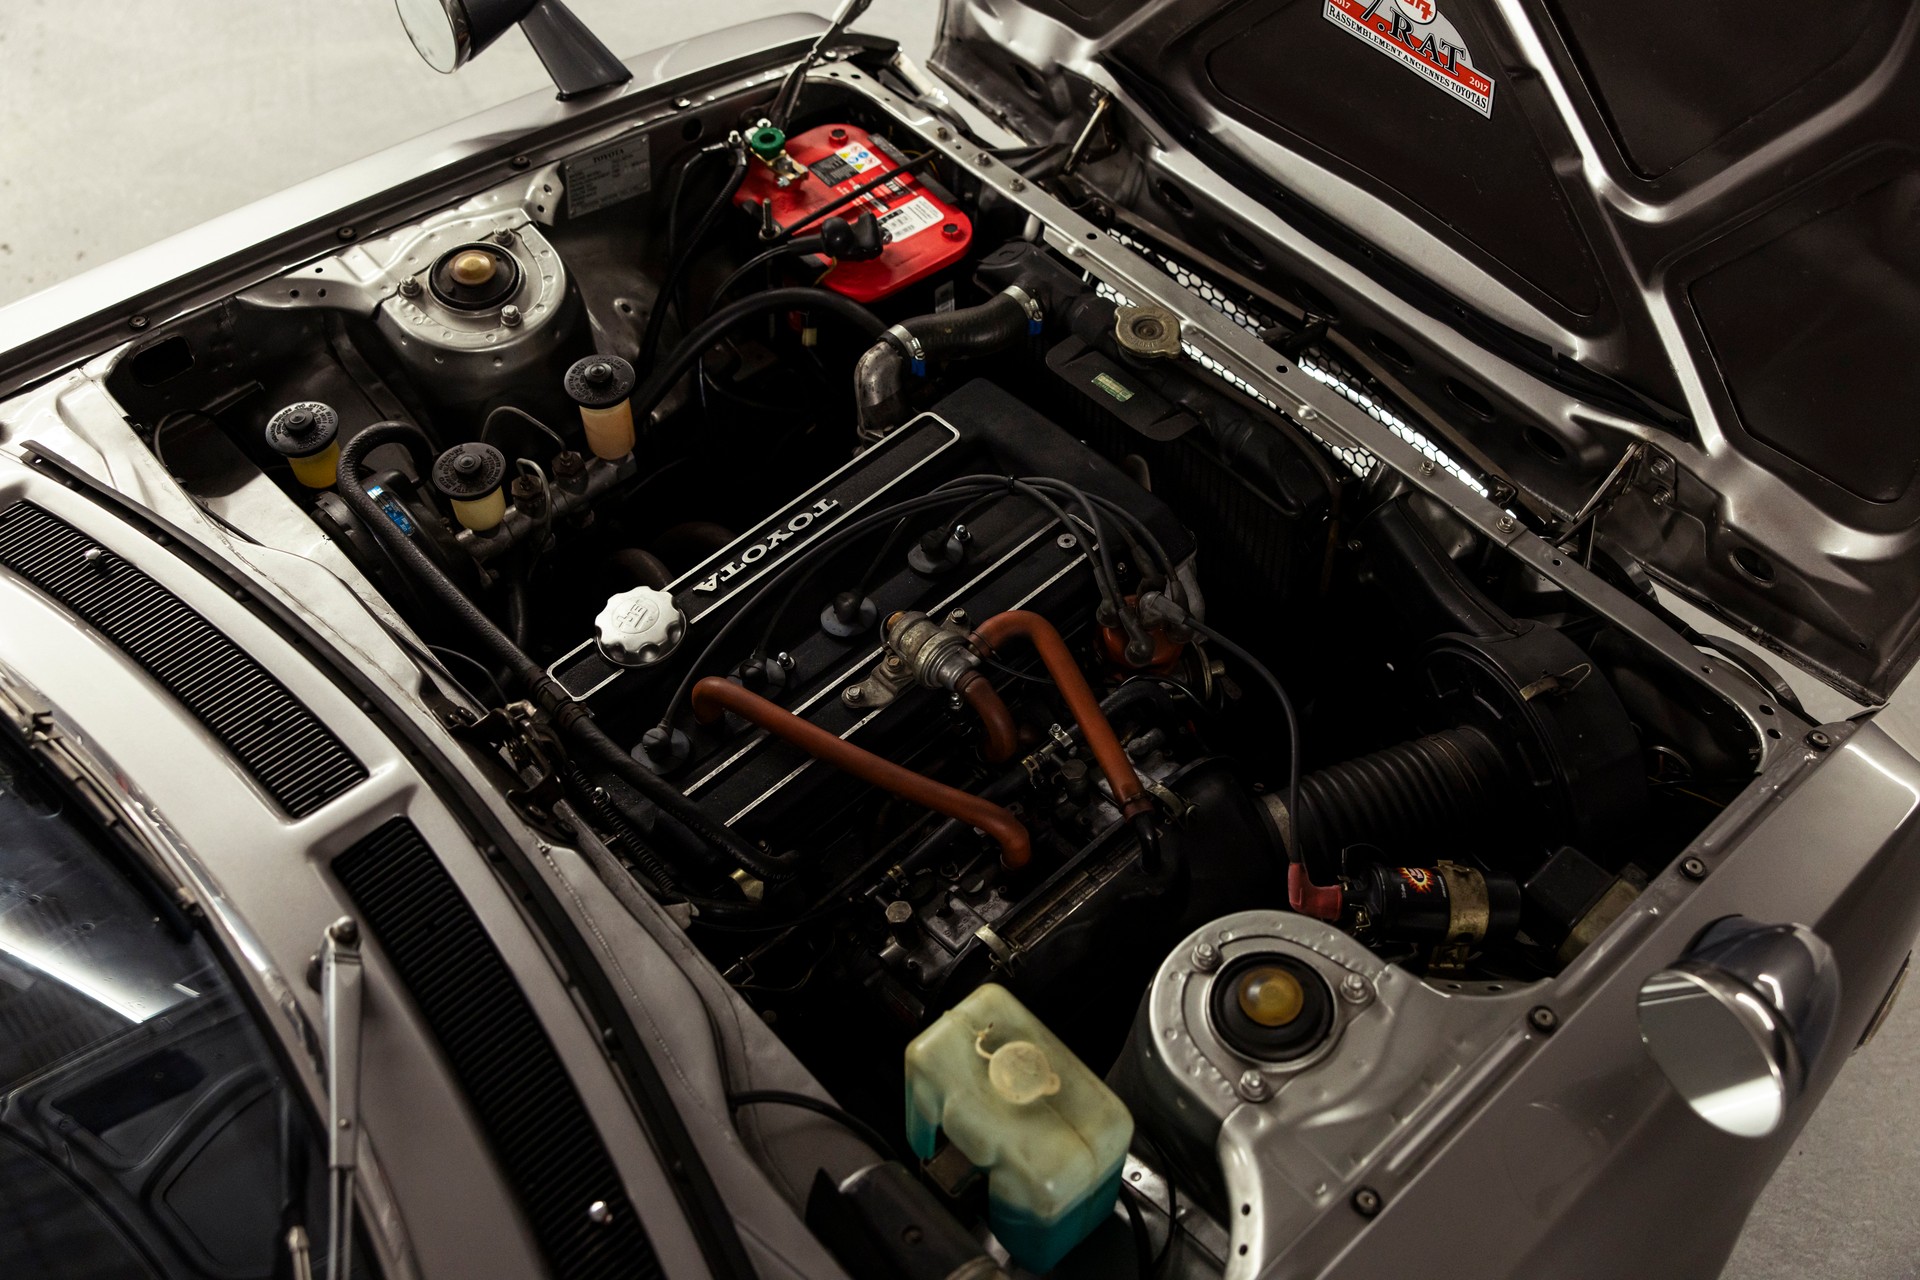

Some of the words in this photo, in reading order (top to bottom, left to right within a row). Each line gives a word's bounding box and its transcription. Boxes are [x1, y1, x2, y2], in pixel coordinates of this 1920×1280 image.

[1329, 5, 1403, 58] RASSEMBLEMENT
[1403, 54, 1451, 87] ANCIENNES
[1451, 80, 1487, 109] TOYOTAS
[1469, 76, 1489, 93] 2017
[593, 149, 624, 163] TOYOTA
[692, 497, 840, 592] TOYOTA
